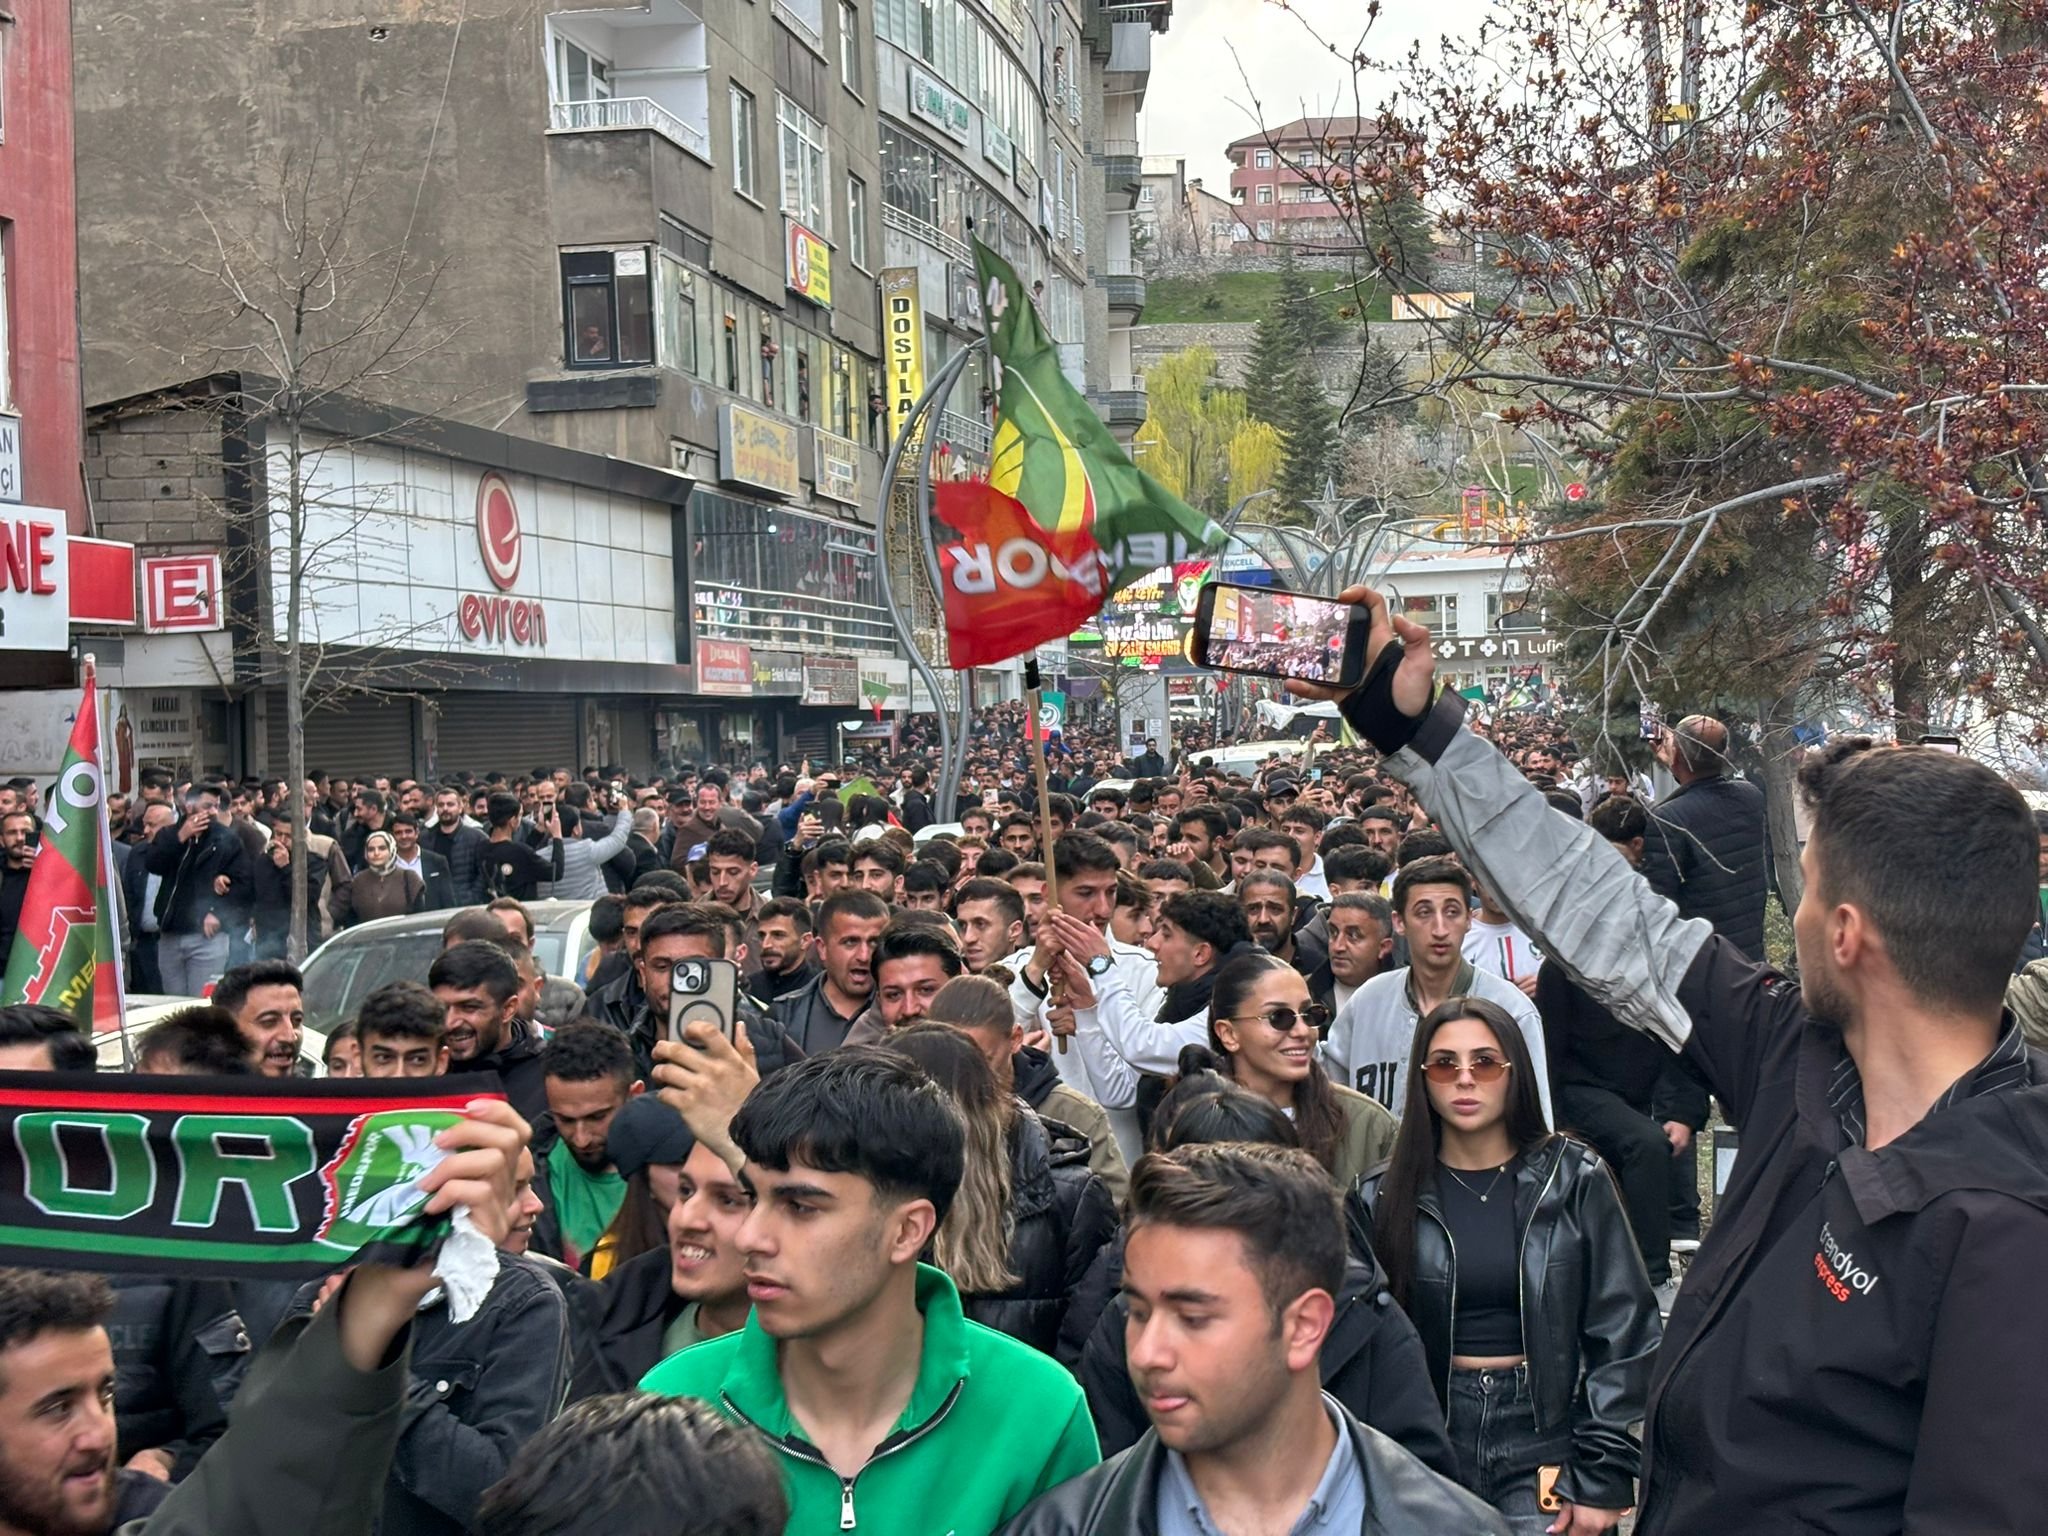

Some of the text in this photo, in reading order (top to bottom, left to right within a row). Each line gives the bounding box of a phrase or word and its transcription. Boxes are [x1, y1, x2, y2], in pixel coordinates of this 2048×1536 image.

[891, 296, 914, 436] DOSTLA
[1223, 558, 1254, 568] RKCELL
[457, 593, 548, 648] evren
[13, 1110, 319, 1234] OR
[1819, 1221, 1879, 1295] trendyol
